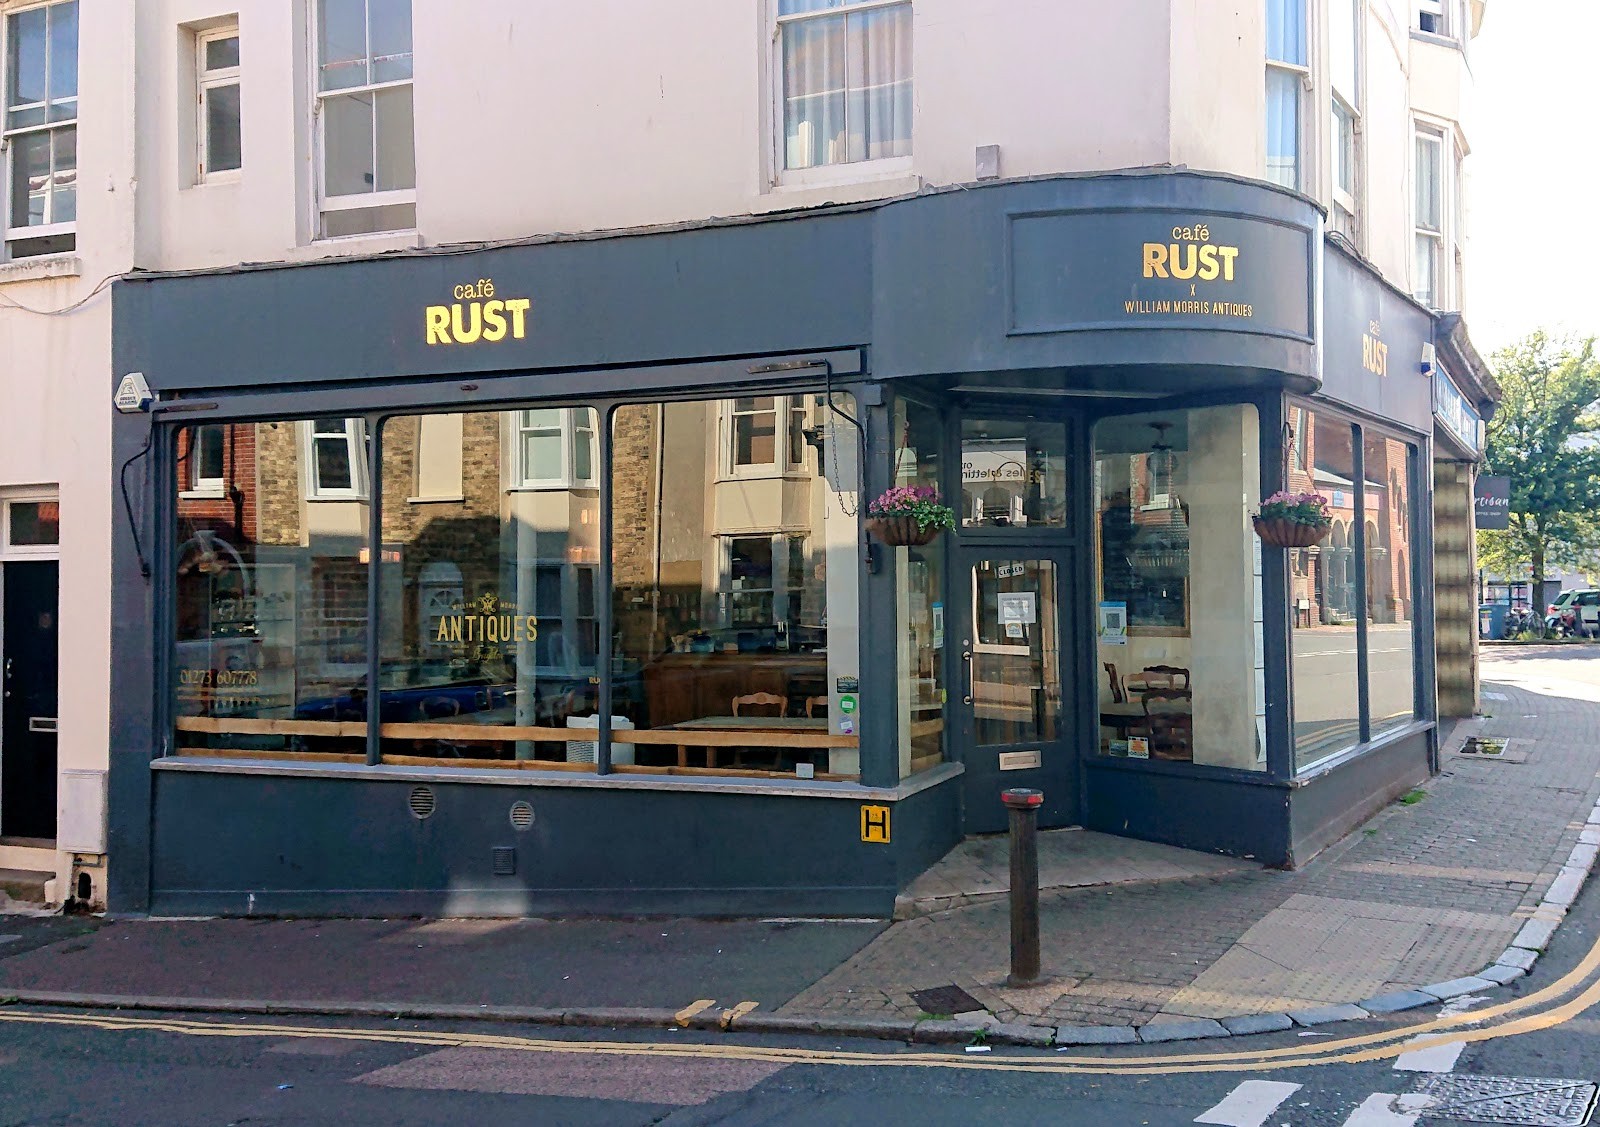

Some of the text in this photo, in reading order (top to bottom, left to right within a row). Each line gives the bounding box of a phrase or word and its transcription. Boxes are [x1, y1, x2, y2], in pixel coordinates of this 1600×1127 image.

[1172, 224, 1210, 241] café
[1143, 243, 1239, 281] RUST
[453, 279, 494, 300] café
[1124, 300, 1253, 317] WILLIAM MORRIS ANTIQUES
[426, 299, 530, 345] RUST
[1362, 333, 1388, 377] RUST
[1475, 496, 1509, 507] rtisan
[999, 566, 1023, 576] CLOSED
[437, 615, 537, 643] ANTIQUES
[180, 669, 212, 685] 01273
[865, 809, 887, 839] H
